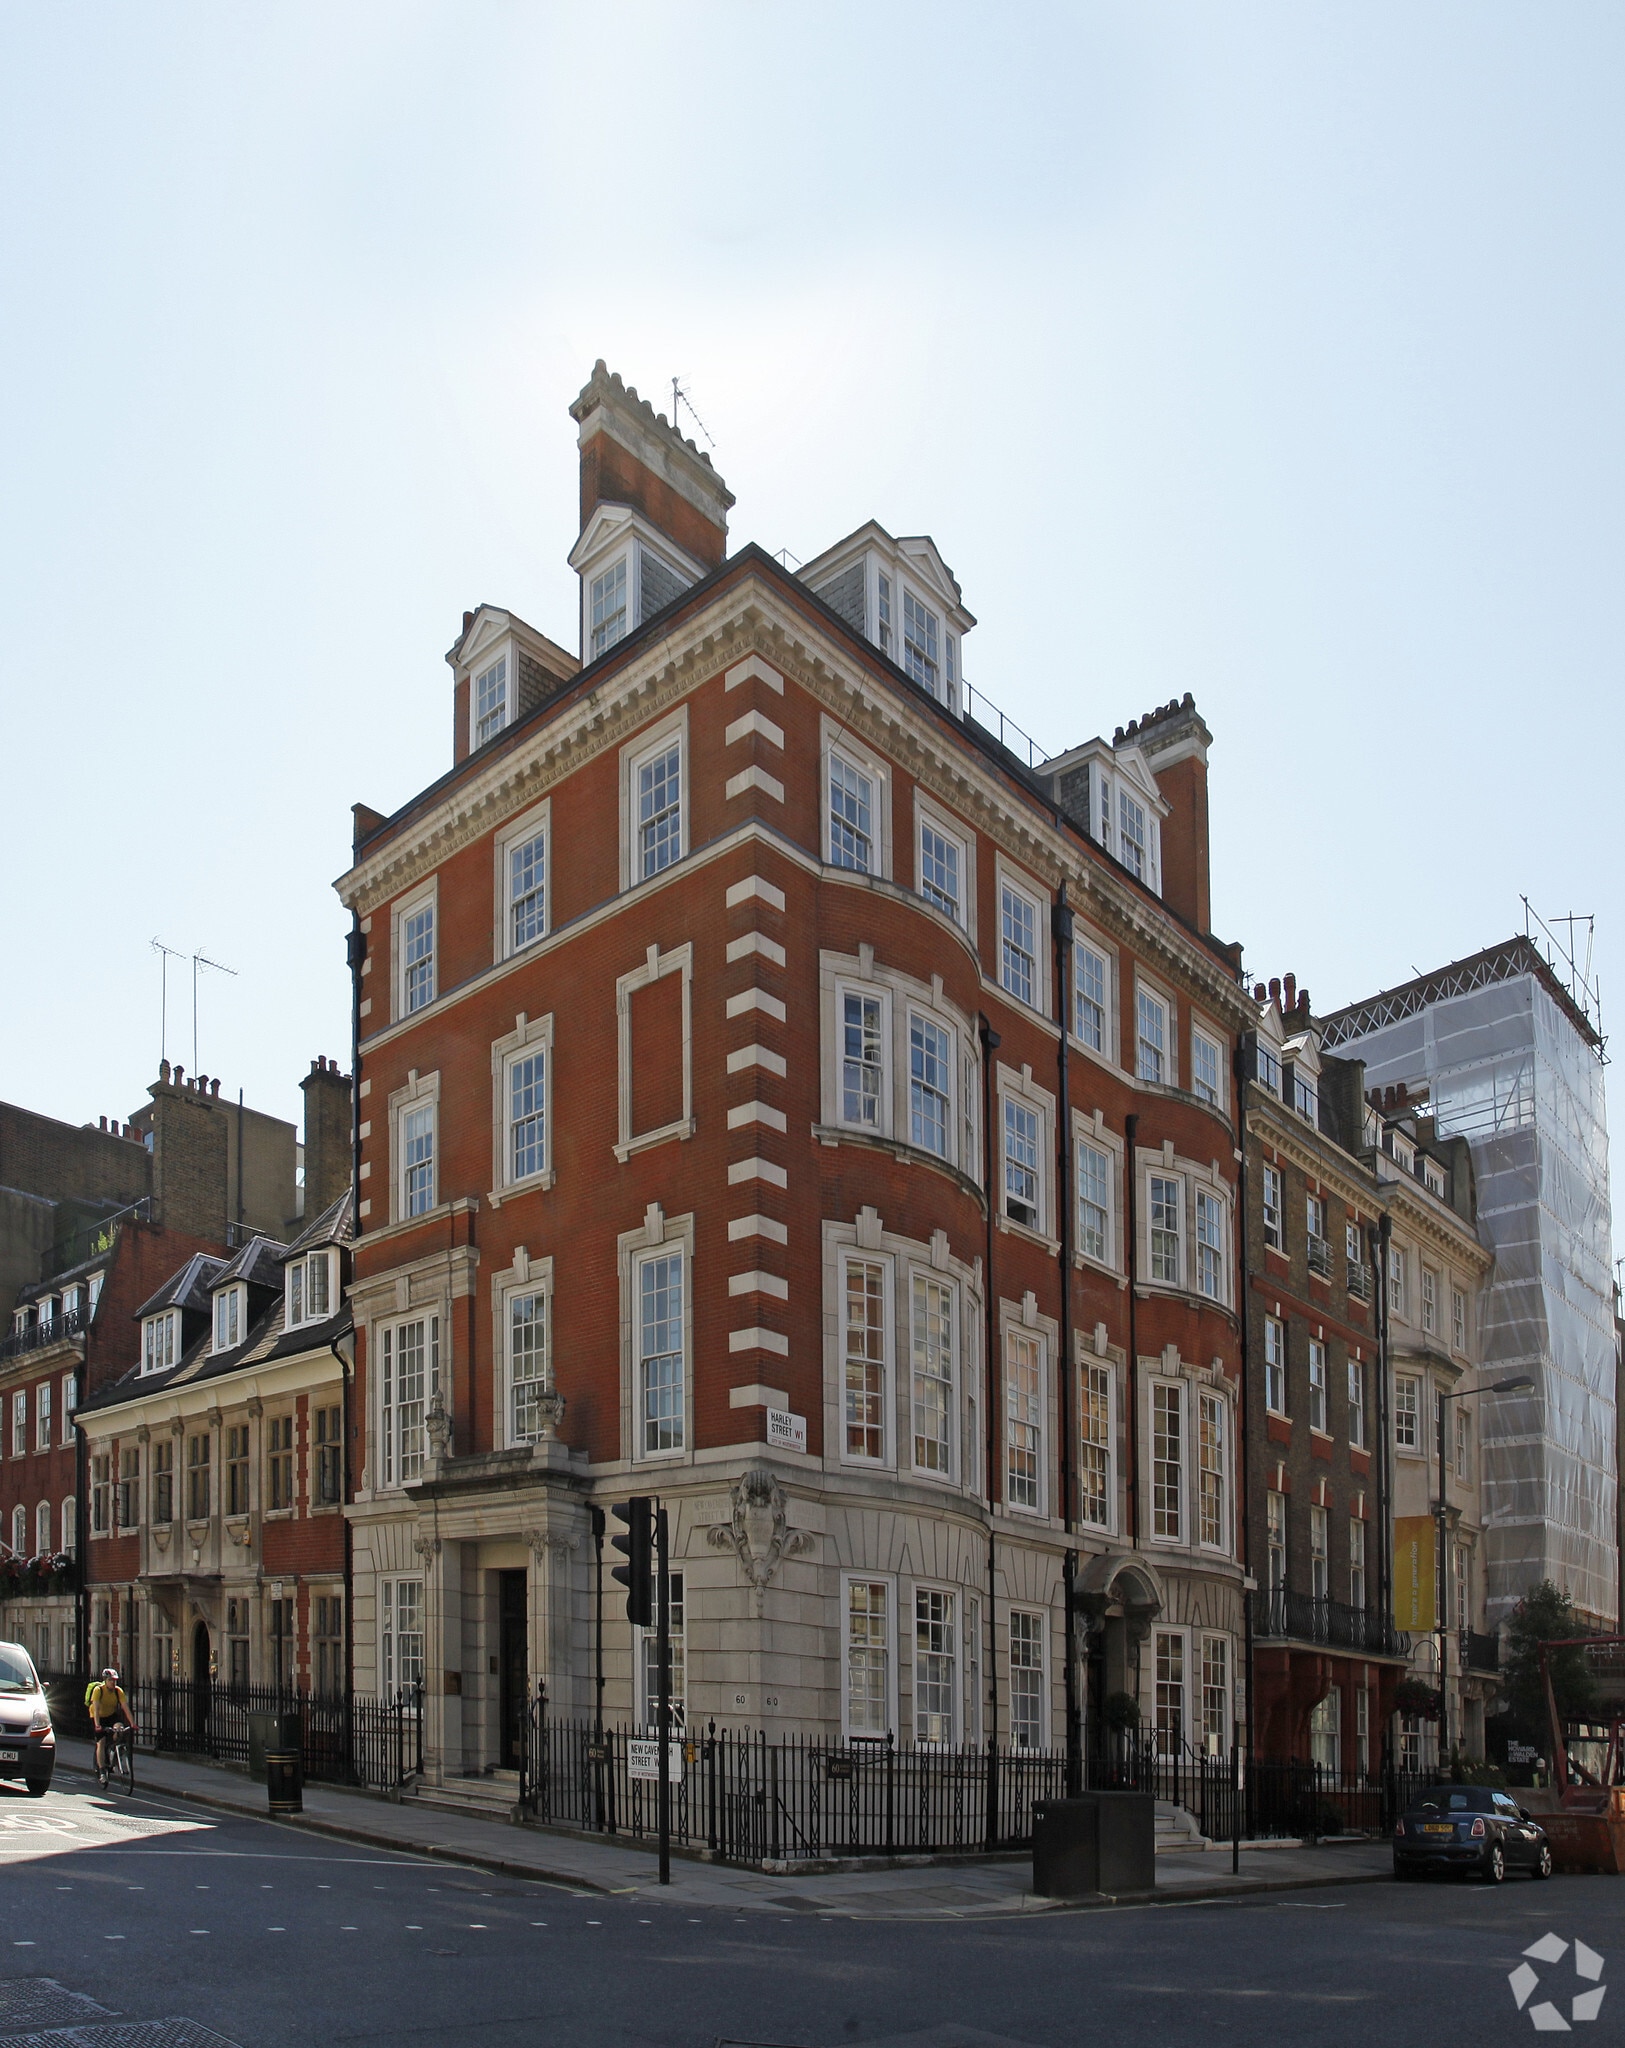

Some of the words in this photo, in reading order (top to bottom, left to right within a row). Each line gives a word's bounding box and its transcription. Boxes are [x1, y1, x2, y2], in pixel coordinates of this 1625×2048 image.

[771, 1412, 792, 1426] HARLEY
[771, 1423, 792, 1437] STREET
[795, 1429, 803, 1440] W1
[1410, 1541, 1418, 1589] generation
[736, 1694, 746, 1704] 60
[766, 1697, 778, 1706] 60
[2, 1751, 16, 1760] CMU
[588, 1747, 597, 1758] 60
[631, 1744, 643, 1754] NEW
[644, 1745, 673, 1757] CAVEH
[631, 1756, 651, 1767] STREET
[831, 1763, 840, 1774] 60
